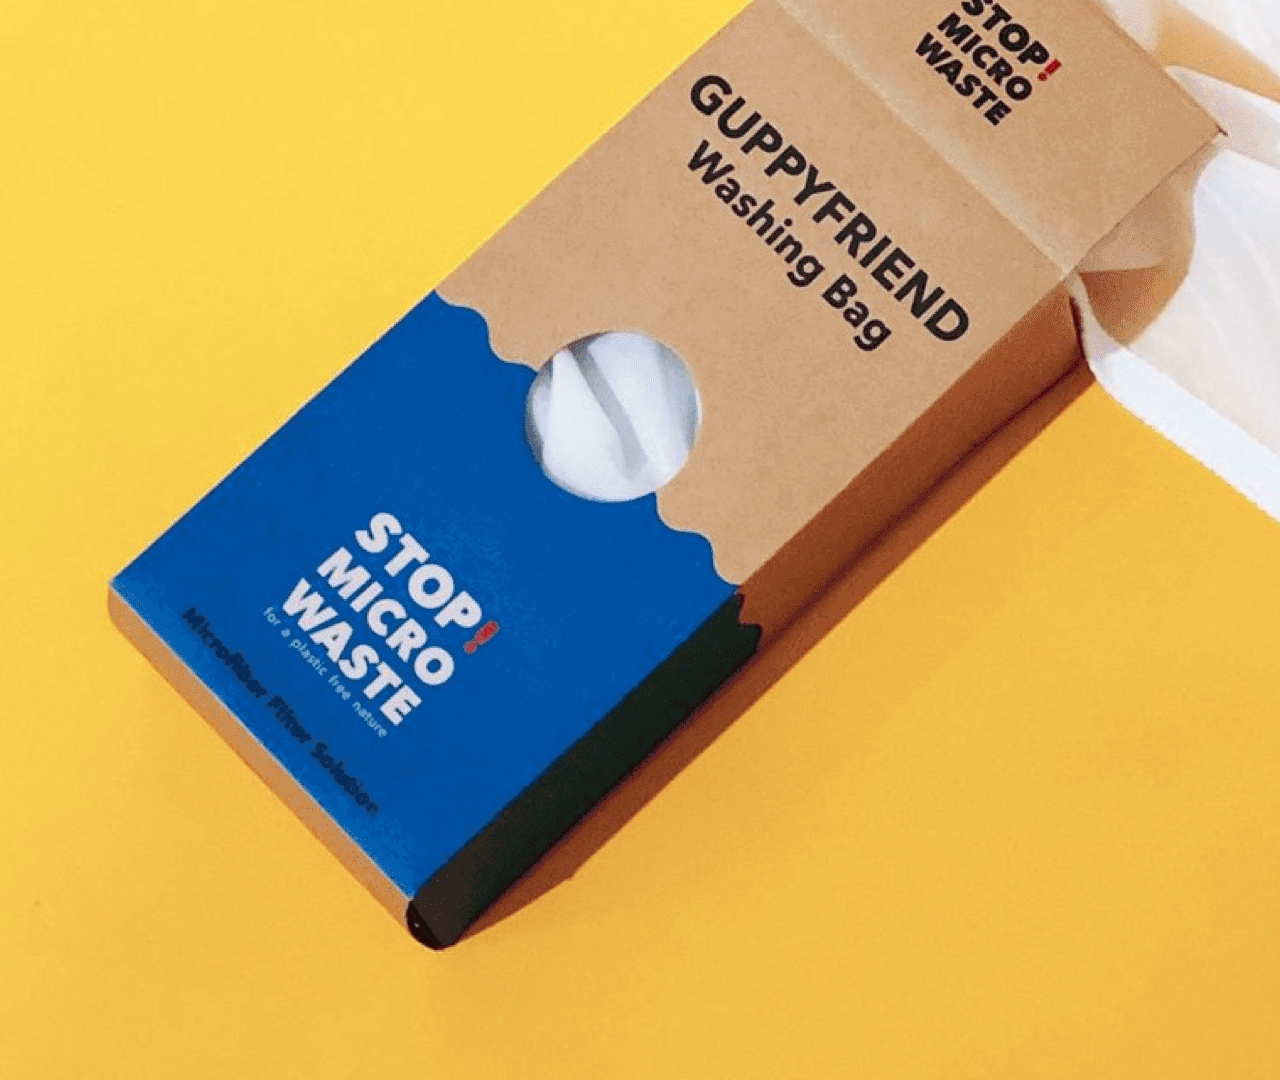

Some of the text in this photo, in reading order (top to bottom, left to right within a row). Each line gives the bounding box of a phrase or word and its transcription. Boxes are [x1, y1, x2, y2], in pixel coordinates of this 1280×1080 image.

[915, 32, 1012, 126] WASTE
[937, 12, 1032, 101] MICRO
[686, 139, 892, 351] Washing Bag
[690, 75, 969, 341] GUPPYFRIEND
[282, 577, 422, 726] WASTE
[317, 546, 454, 685] MICRO
[355, 512, 499, 654] STOP!
[263, 606, 281, 626] for
[288, 639, 327, 676] plastic
[328, 674, 351, 701] free
[352, 701, 388, 738] nature
